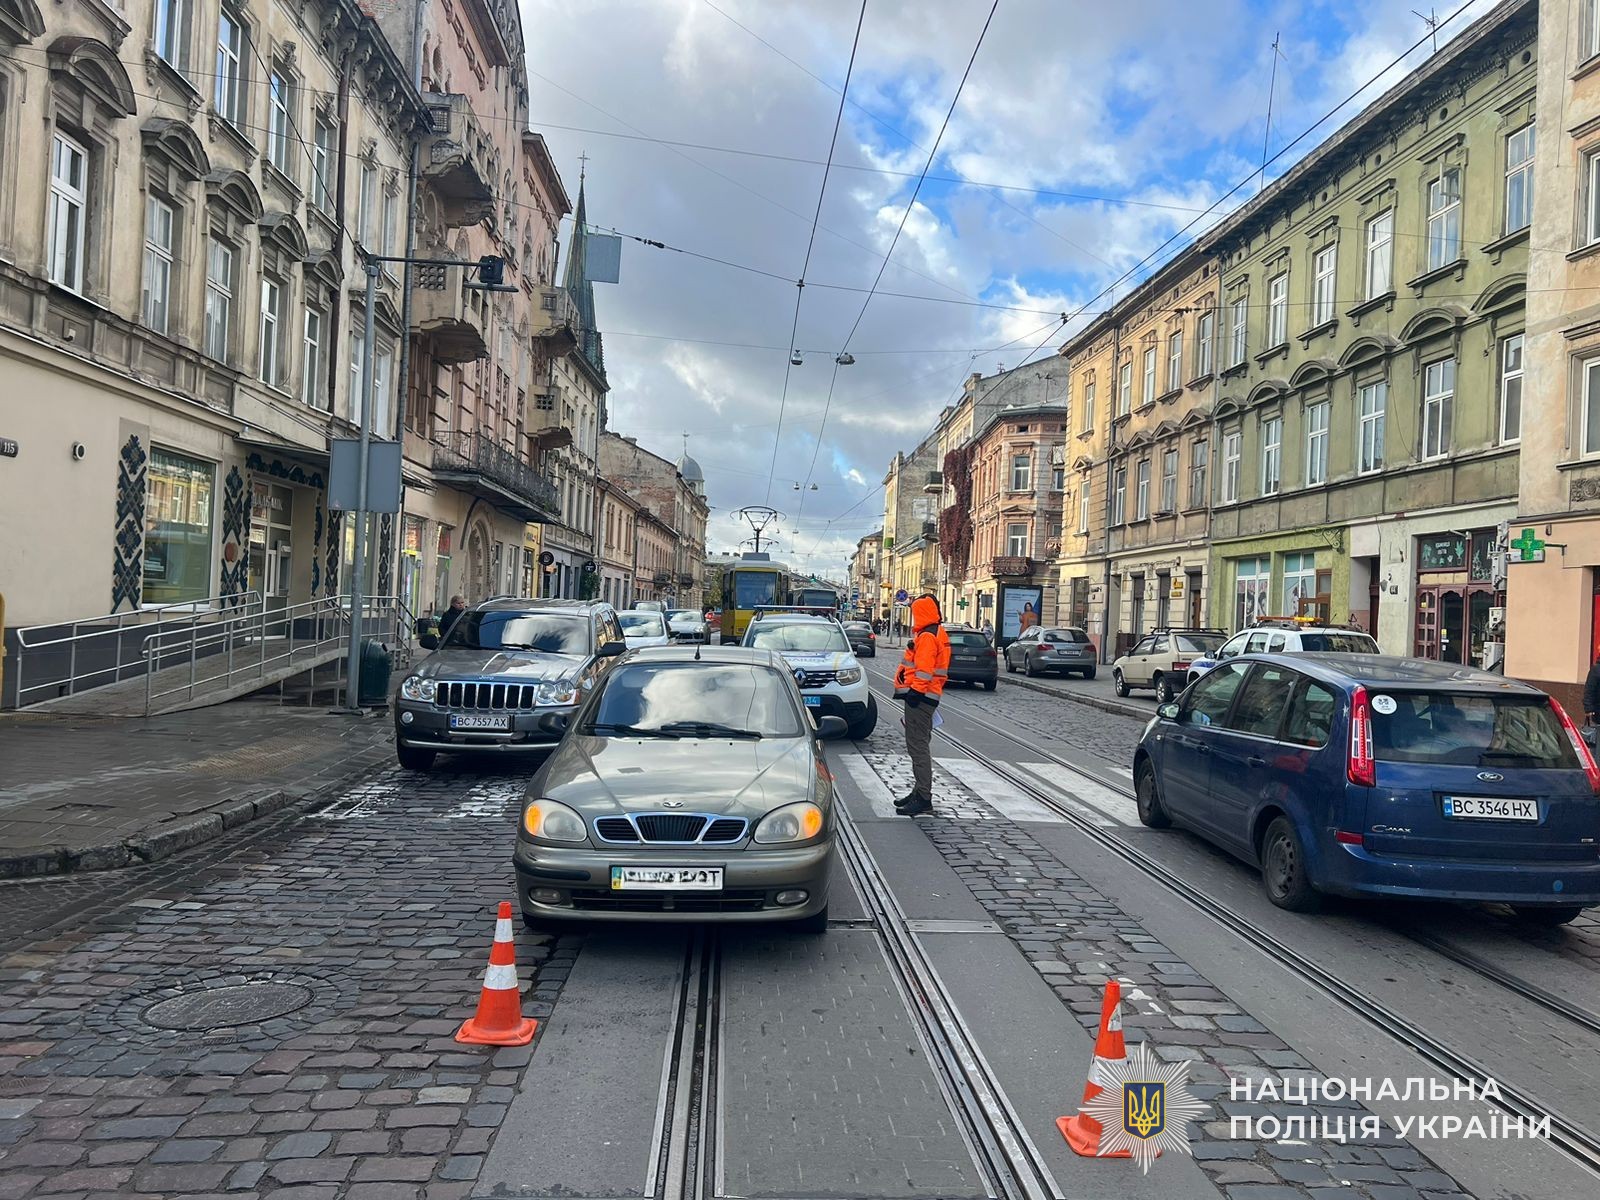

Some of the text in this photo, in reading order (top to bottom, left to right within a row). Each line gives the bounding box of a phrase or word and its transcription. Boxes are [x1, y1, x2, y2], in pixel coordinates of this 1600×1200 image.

[4, 442, 15, 454] 115
[458, 717, 506, 727] BC 7557 AX
[1453, 799, 1532, 817] BC 3546 HX
